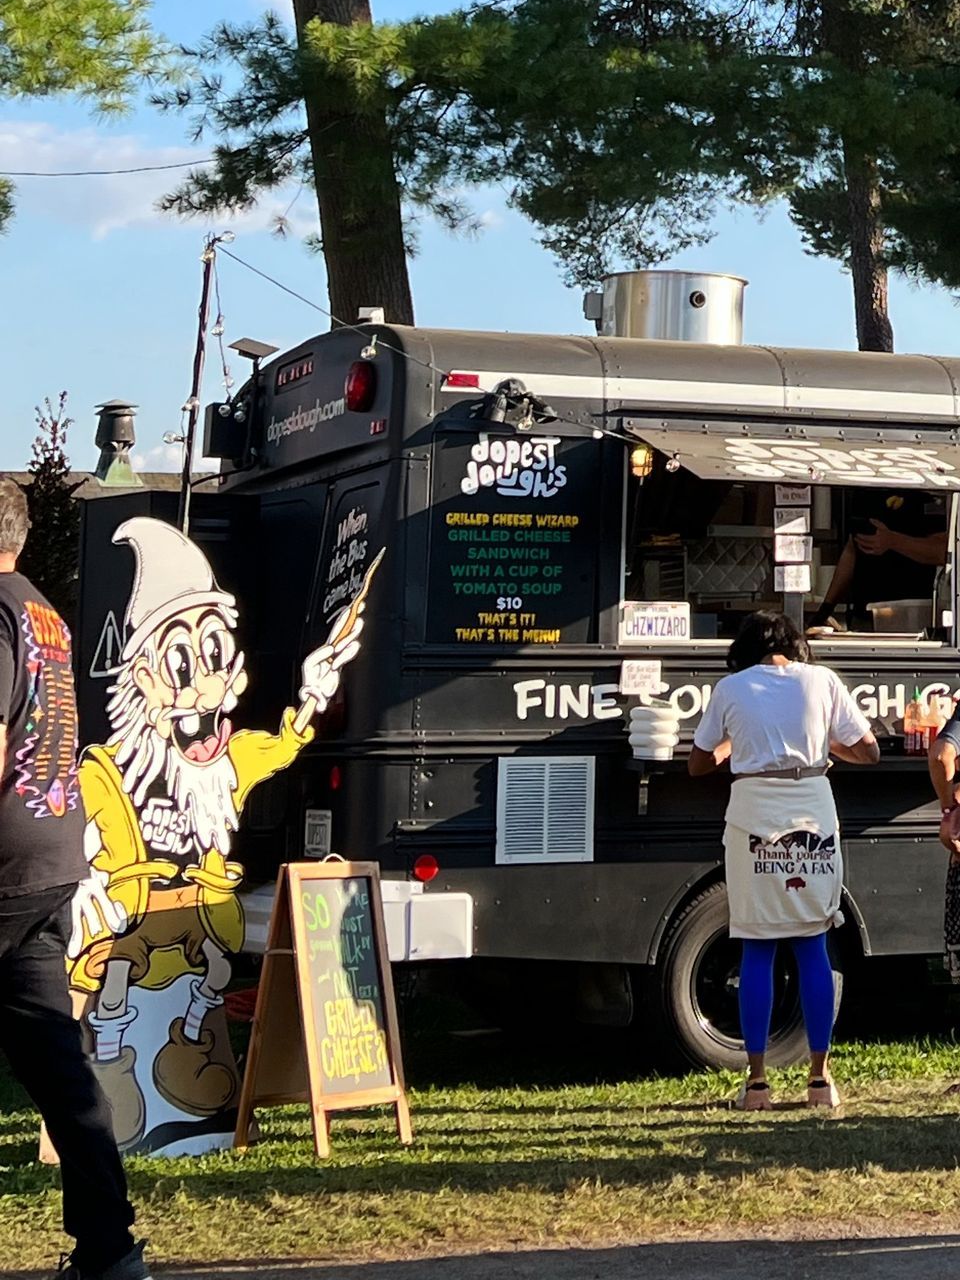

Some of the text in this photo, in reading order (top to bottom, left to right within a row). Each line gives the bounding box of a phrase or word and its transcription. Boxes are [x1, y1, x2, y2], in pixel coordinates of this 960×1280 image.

[267, 398, 345, 447] dopestdough.com
[471, 433, 561, 477] dopest
[446, 512, 579, 528] GRILLED CHEESE WIZARD
[448, 530, 571, 543] GRILLED CHEESE
[467, 547, 550, 560] SANDWICH
[450, 565, 563, 577] WITH A CUP OF
[453, 582, 562, 595] TOMATO SOUP
[496, 597, 522, 611] $10
[478, 613, 535, 627] THAT'S IT!
[625, 616, 687, 637] CHZWIZARD
[456, 628, 560, 644] THAT'S THE MENU!
[513, 679, 623, 720] FINE
[757, 848, 793, 860] Thank
[754, 861, 835, 875] BEING A FAN
[301, 892, 331, 931] SO
